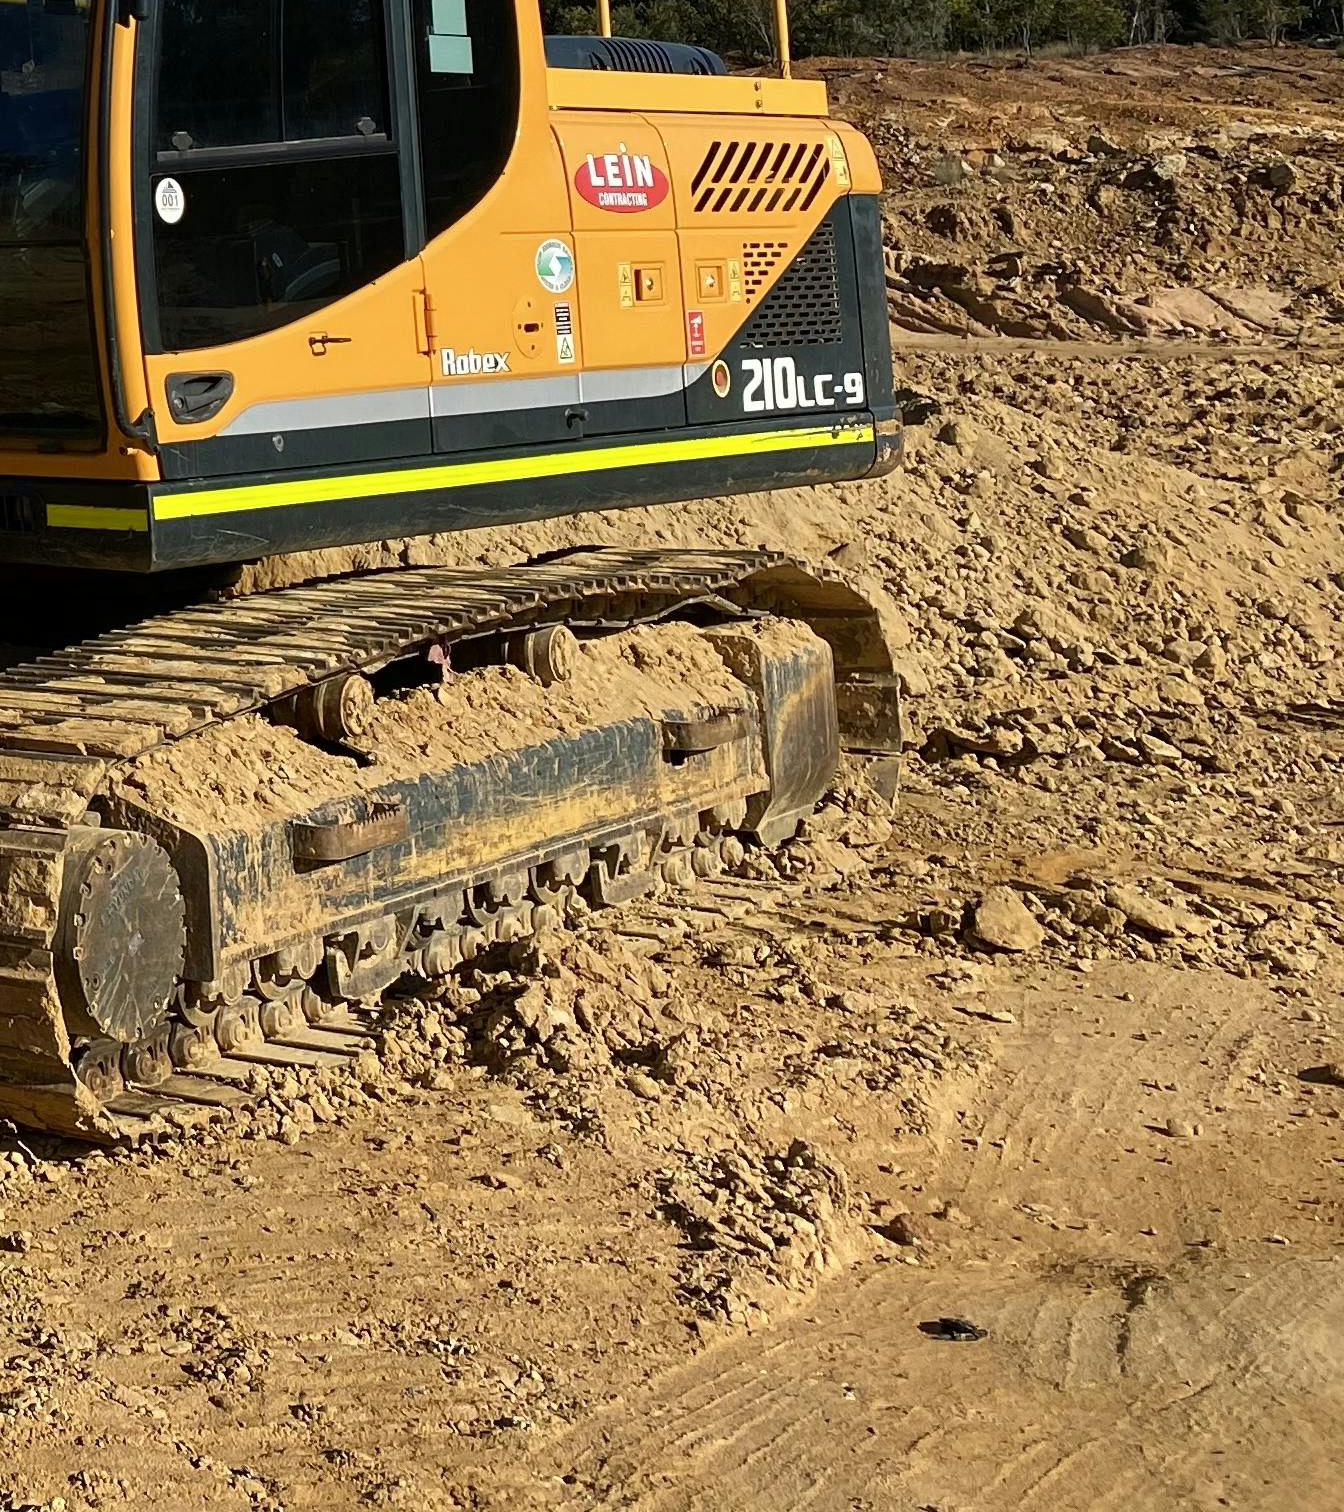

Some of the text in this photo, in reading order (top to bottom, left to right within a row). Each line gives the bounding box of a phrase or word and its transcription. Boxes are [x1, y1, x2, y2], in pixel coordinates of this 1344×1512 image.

[162, 193, 179, 207] 001
[598, 191, 649, 207] CONTRACTING
[440, 347, 512, 377] Robex
